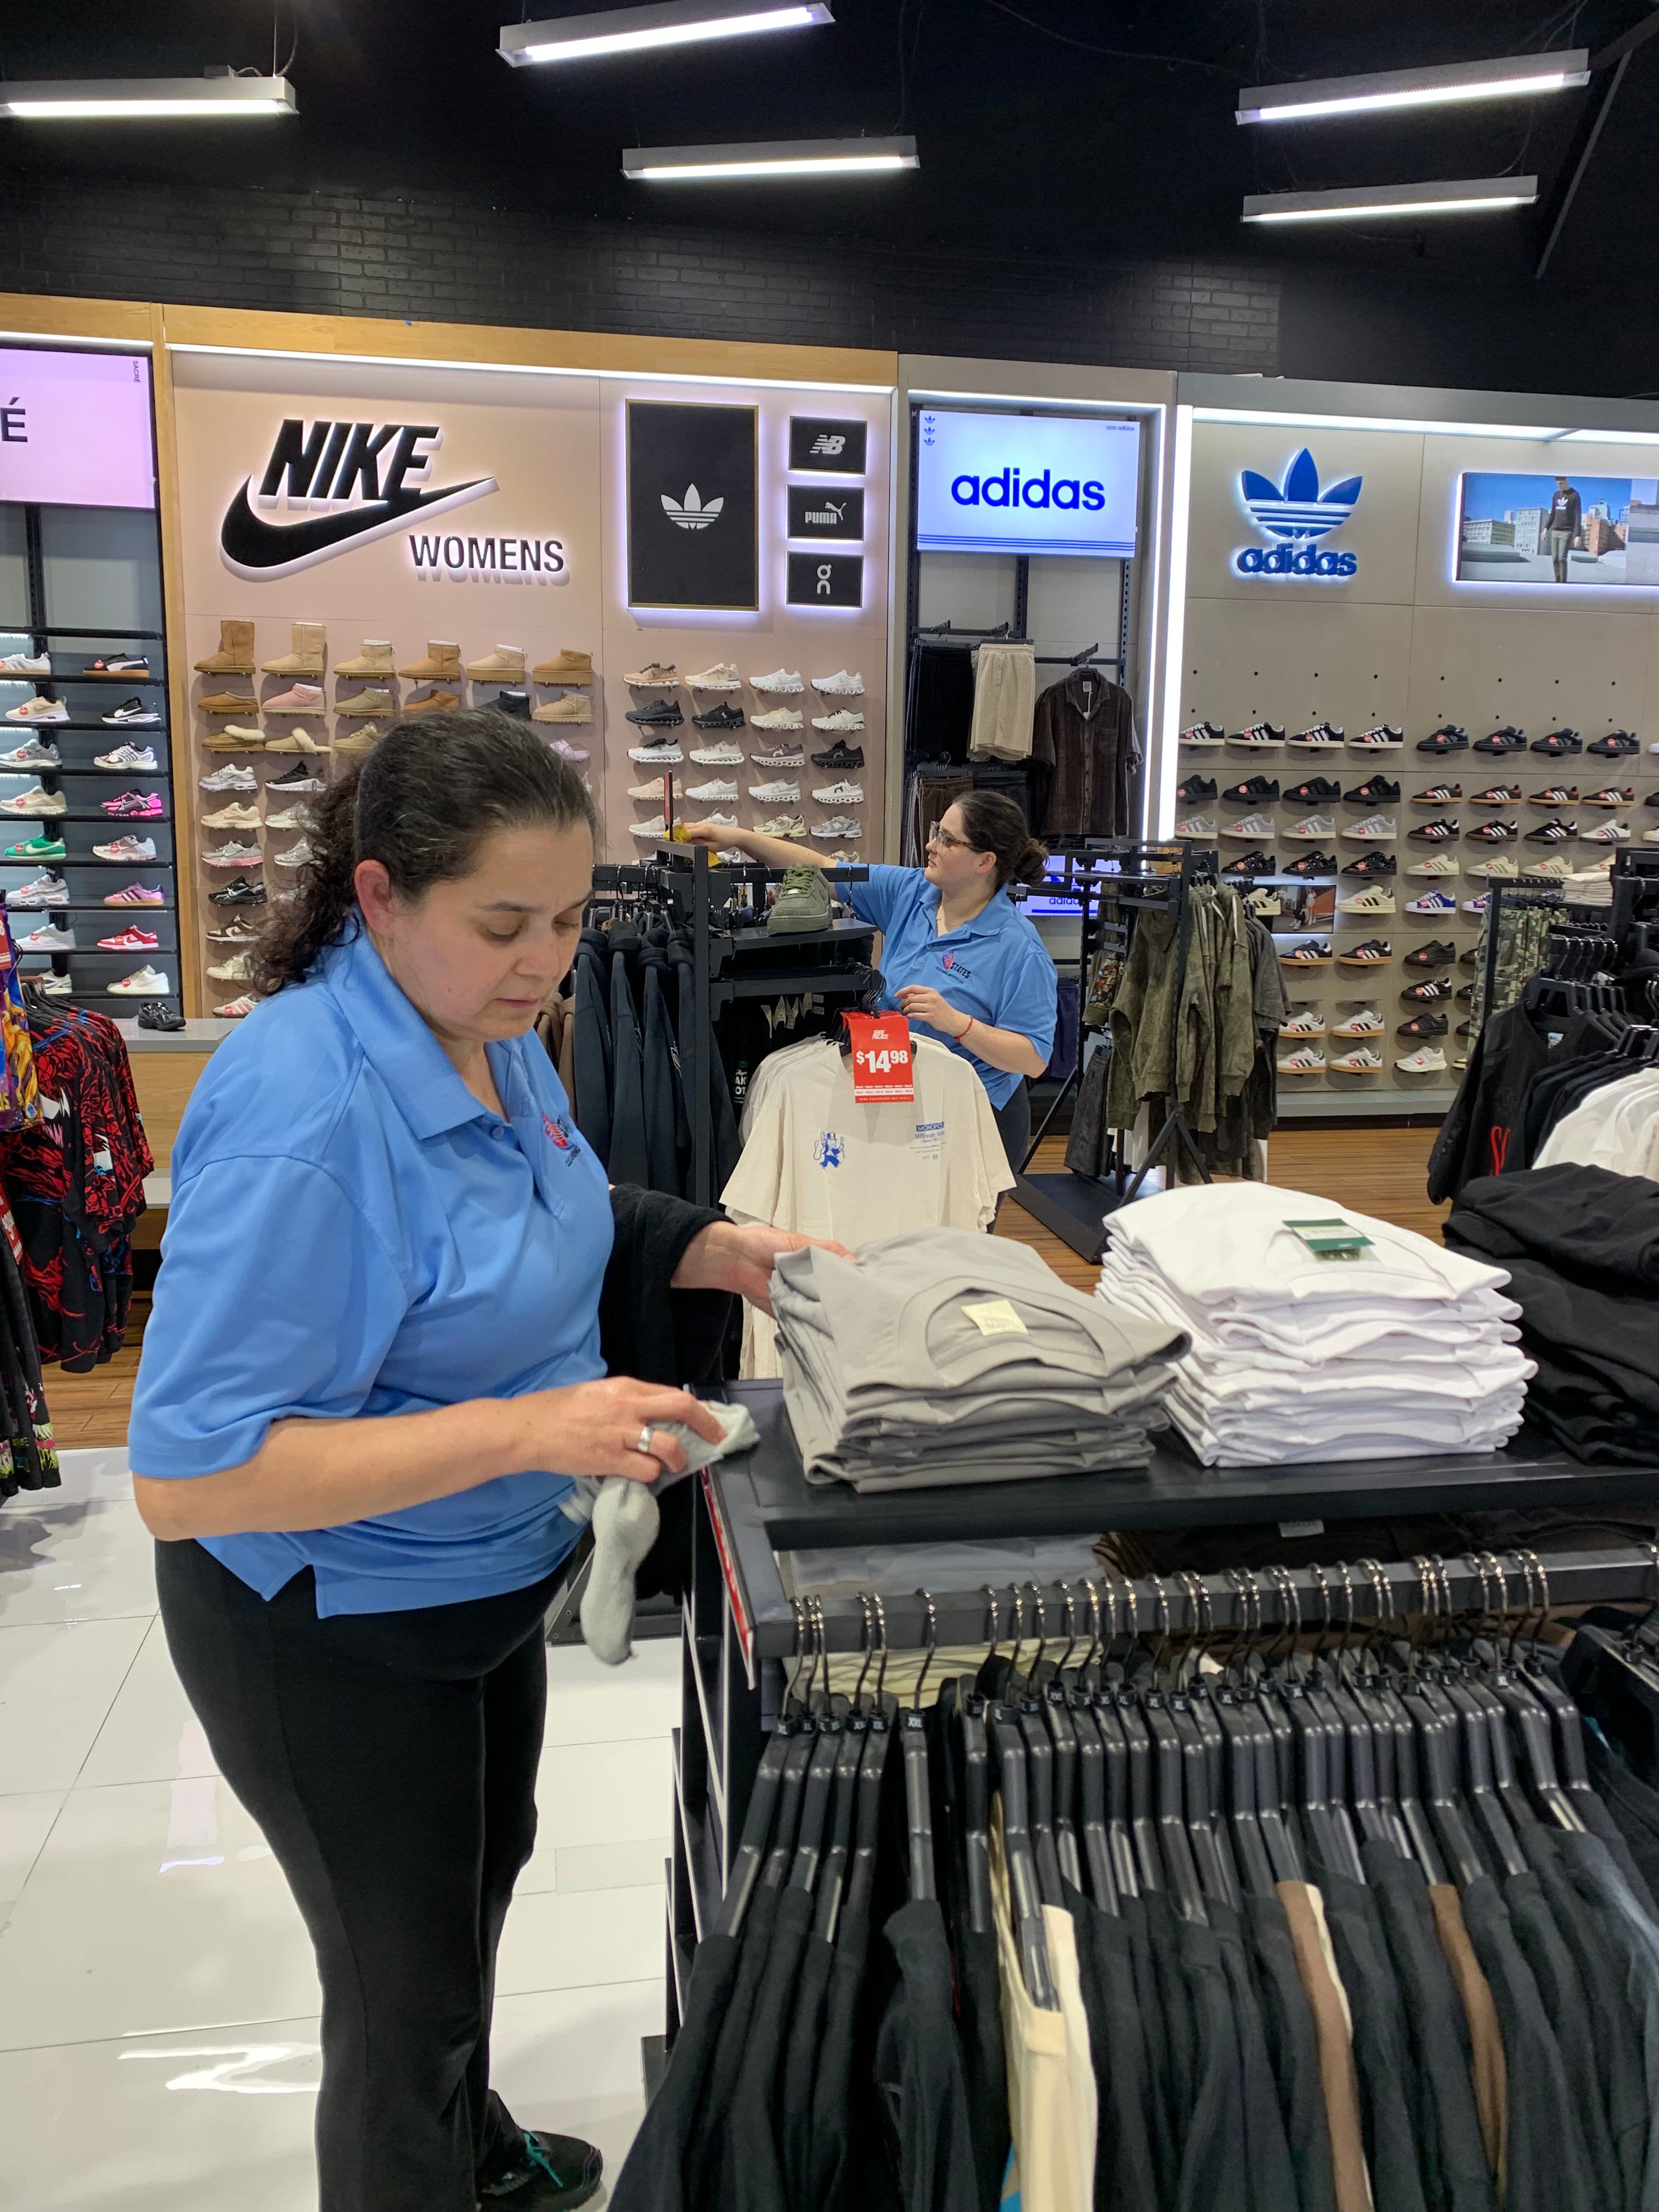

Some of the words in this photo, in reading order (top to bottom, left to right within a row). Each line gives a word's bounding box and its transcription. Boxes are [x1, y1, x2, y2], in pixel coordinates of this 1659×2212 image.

[133, 360, 141, 383] SACRÉ
[258, 419, 441, 501] NIKE
[951, 467, 1105, 511] adidas
[805, 511, 838, 524] PUMA
[409, 534, 565, 572] WOMENS
[1237, 543, 1358, 577] adidas
[1048, 896, 1079, 905] adida
[950, 962, 972, 979] STATES
